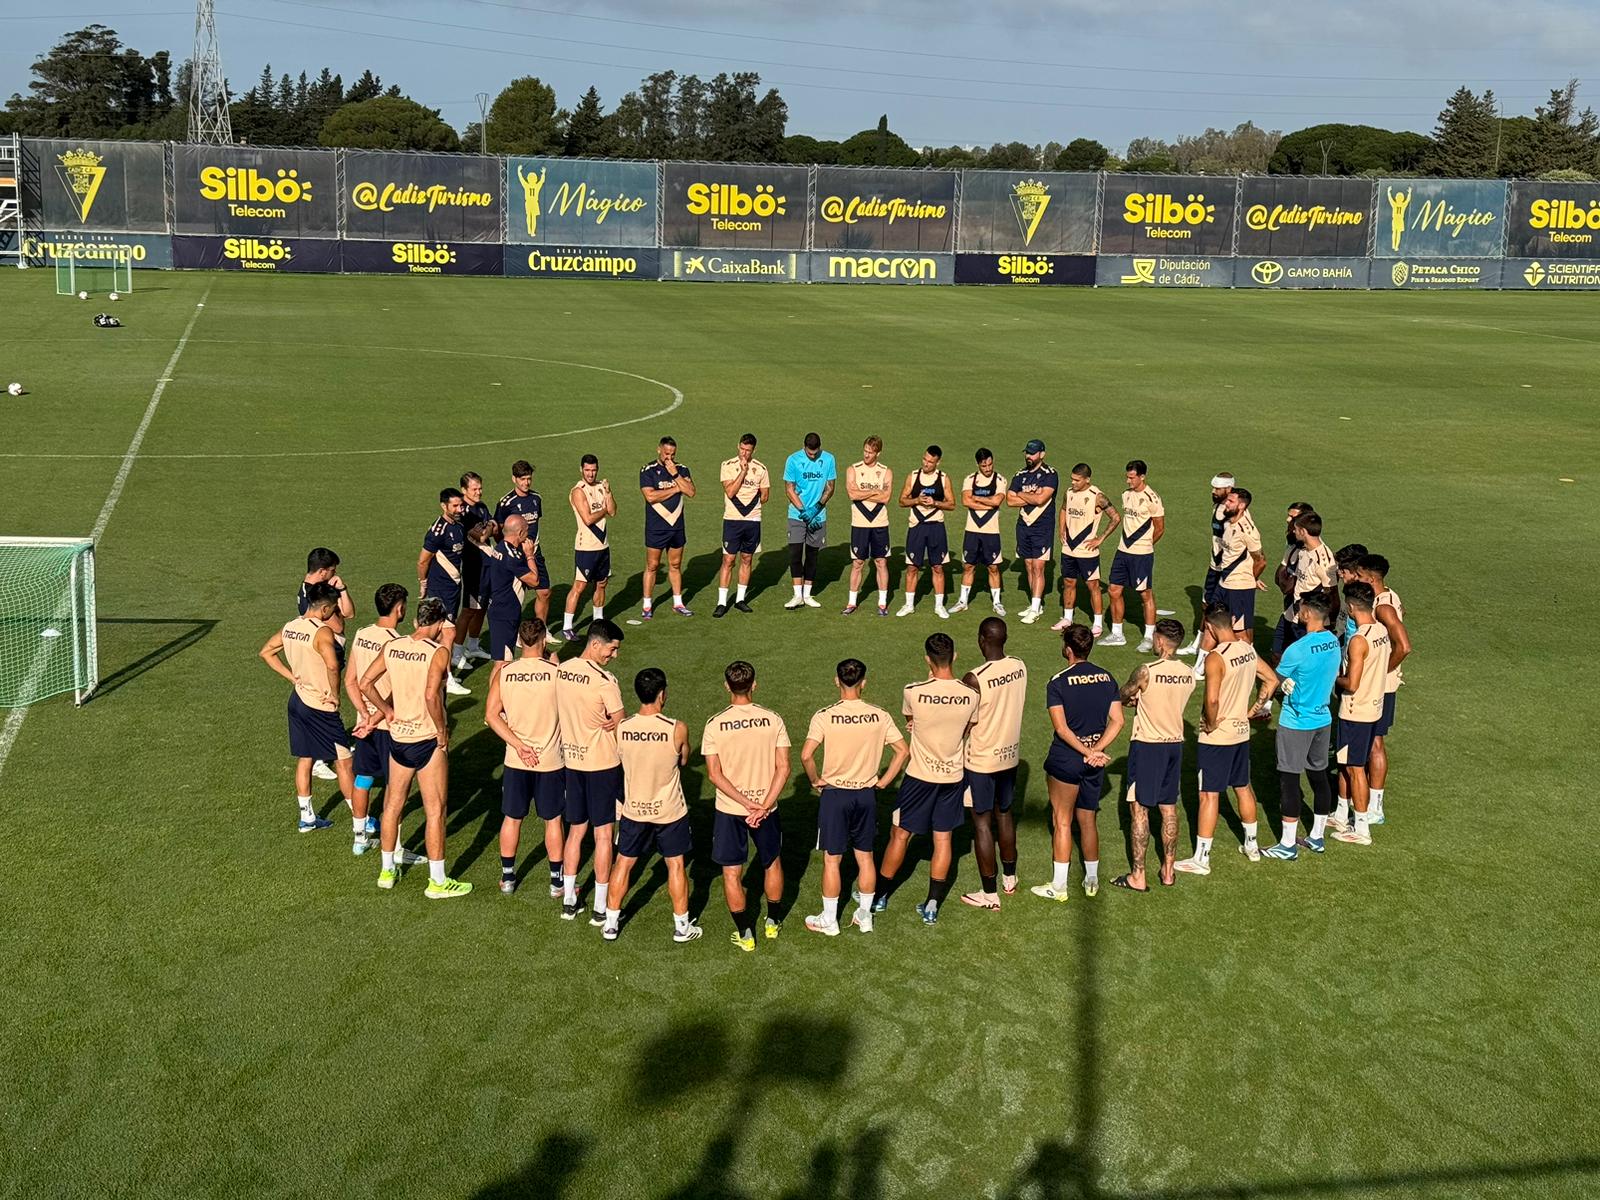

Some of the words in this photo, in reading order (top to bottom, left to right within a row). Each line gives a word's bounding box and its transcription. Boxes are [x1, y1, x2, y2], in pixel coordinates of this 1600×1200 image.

[200, 166, 300, 203] Silbö
[548, 182, 647, 225] Mágico
[686, 182, 776, 217] Silbö
[228, 203, 286, 218] Telecom
[1123, 192, 1206, 225] Silbö
[710, 218, 761, 231] Telecom
[1411, 199, 1497, 238] Mágico
[1145, 226, 1191, 238] Telecom
[1548, 231, 1592, 243] Telecom
[23, 236, 146, 263] Cruzcampo
[224, 238, 284, 260] Silbö
[392, 243, 449, 264] Silbö
[240, 260, 276, 269] Telecom
[408, 264, 442, 273] Telecom
[528, 250, 637, 276] Cruzcampo
[708, 258, 786, 275] CaixaBank
[829, 256, 936, 279] macron
[997, 255, 1049, 275] Silbö
[1159, 258, 1211, 270] Diputación
[1287, 268, 1320, 278] GAMO
[1322, 266, 1353, 278] BAHÍA
[1411, 265, 1448, 275] PETACA
[1449, 265, 1481, 275] CHICO
[1010, 275, 1040, 284] Telecom
[1159, 274, 1172, 284] de
[1174, 273, 1200, 285] Cádiz
[284, 629, 311, 643] macron
[355, 637, 382, 651] macro
[388, 649, 427, 662] macron
[505, 671, 551, 683] macron
[987, 668, 1025, 689] macron
[1067, 673, 1111, 686] macron
[1155, 674, 1193, 685] macron
[918, 693, 970, 705] macron
[719, 716, 771, 732] macron
[831, 713, 880, 725] macron
[622, 730, 669, 742] macron
